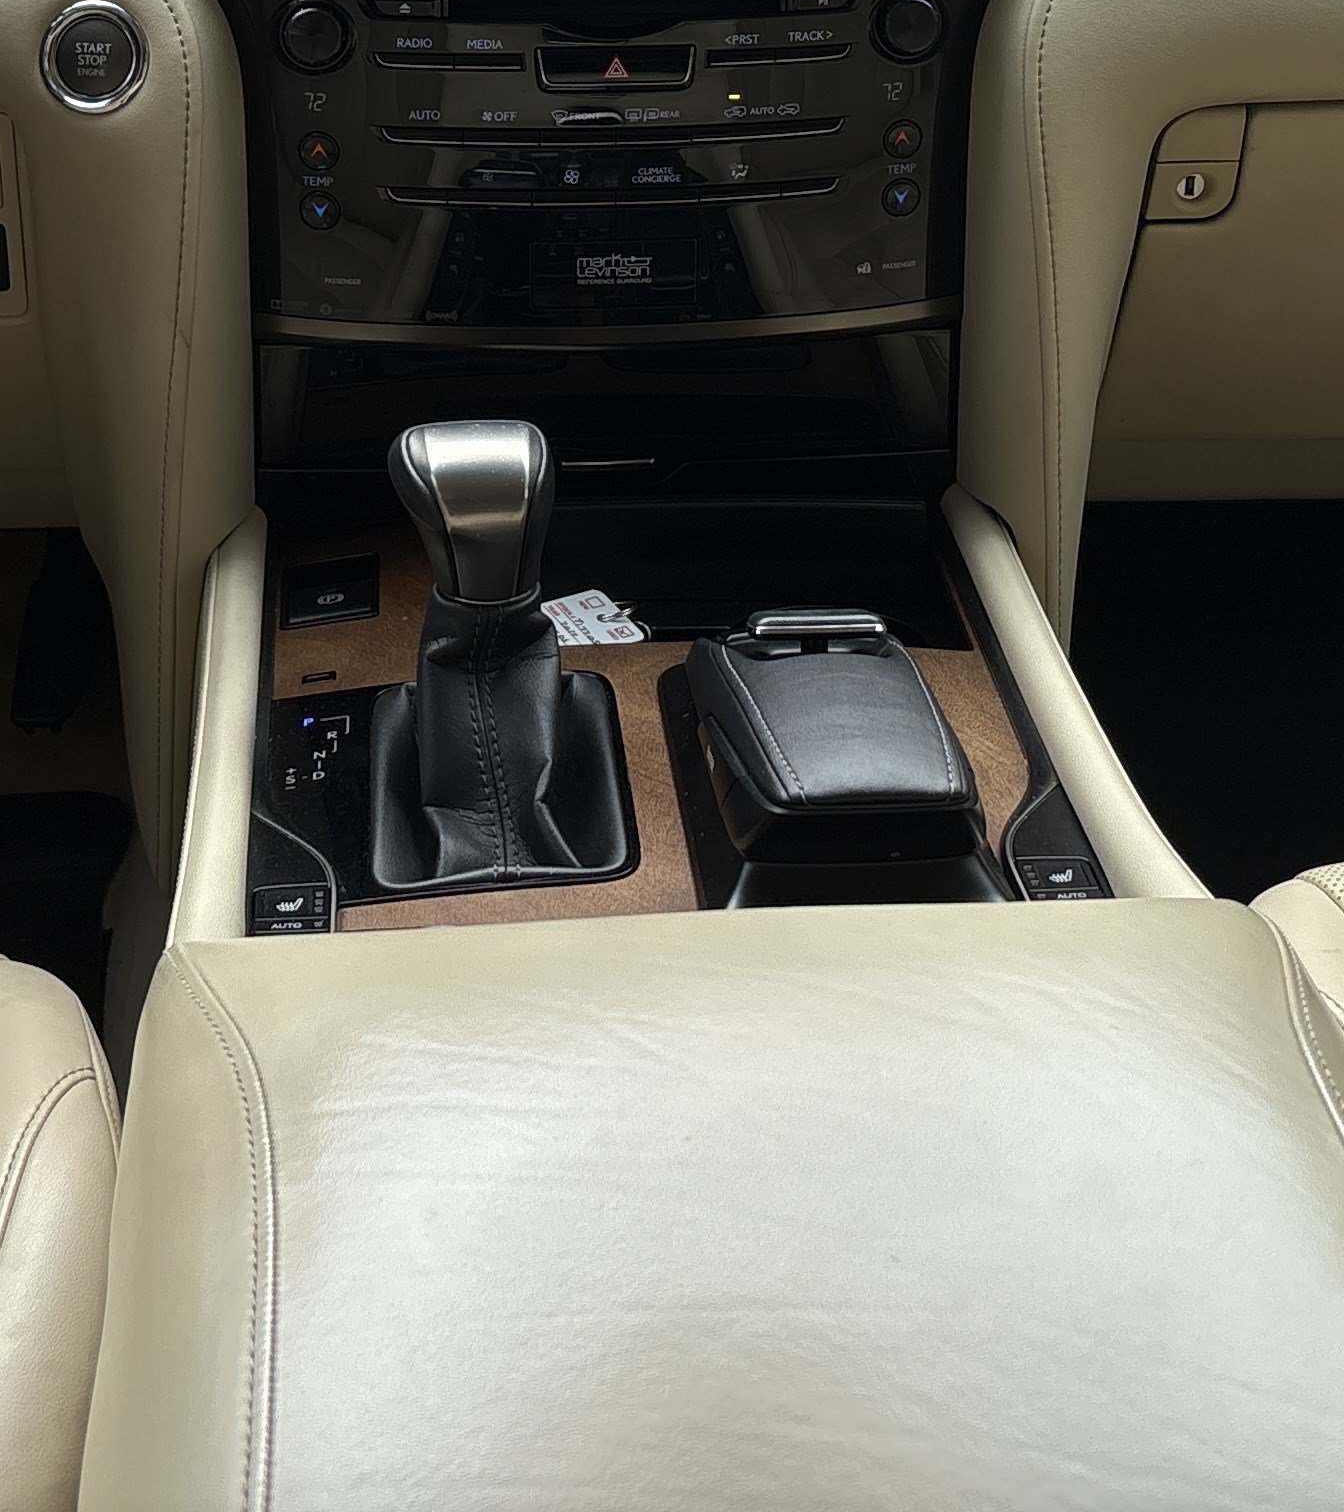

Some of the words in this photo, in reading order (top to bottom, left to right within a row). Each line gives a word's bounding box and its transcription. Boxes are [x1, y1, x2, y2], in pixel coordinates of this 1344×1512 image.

[396, 37, 433, 49] RADIO
[466, 39, 503, 50] MEDIA
[75, 42, 112, 55] START
[77, 54, 107, 66] STOP
[77, 67, 106, 78] ENGINE
[882, 81, 903, 100] 72
[304, 92, 327, 111] 72
[408, 110, 440, 120] AUTO
[660, 109, 681, 119] REAR
[750, 106, 774, 115] AUTO
[494, 111, 517, 122] OFF
[637, 167, 674, 176] CLIMATE
[887, 163, 917, 175] TEMP
[302, 175, 334, 187] TEMP
[631, 174, 682, 184] CONCIERGE
[303, 717, 314, 727] P
[326, 731, 337, 739] R
[313, 750, 326, 760] N
[285, 775, 296, 784] S
[312, 771, 325, 780] D
